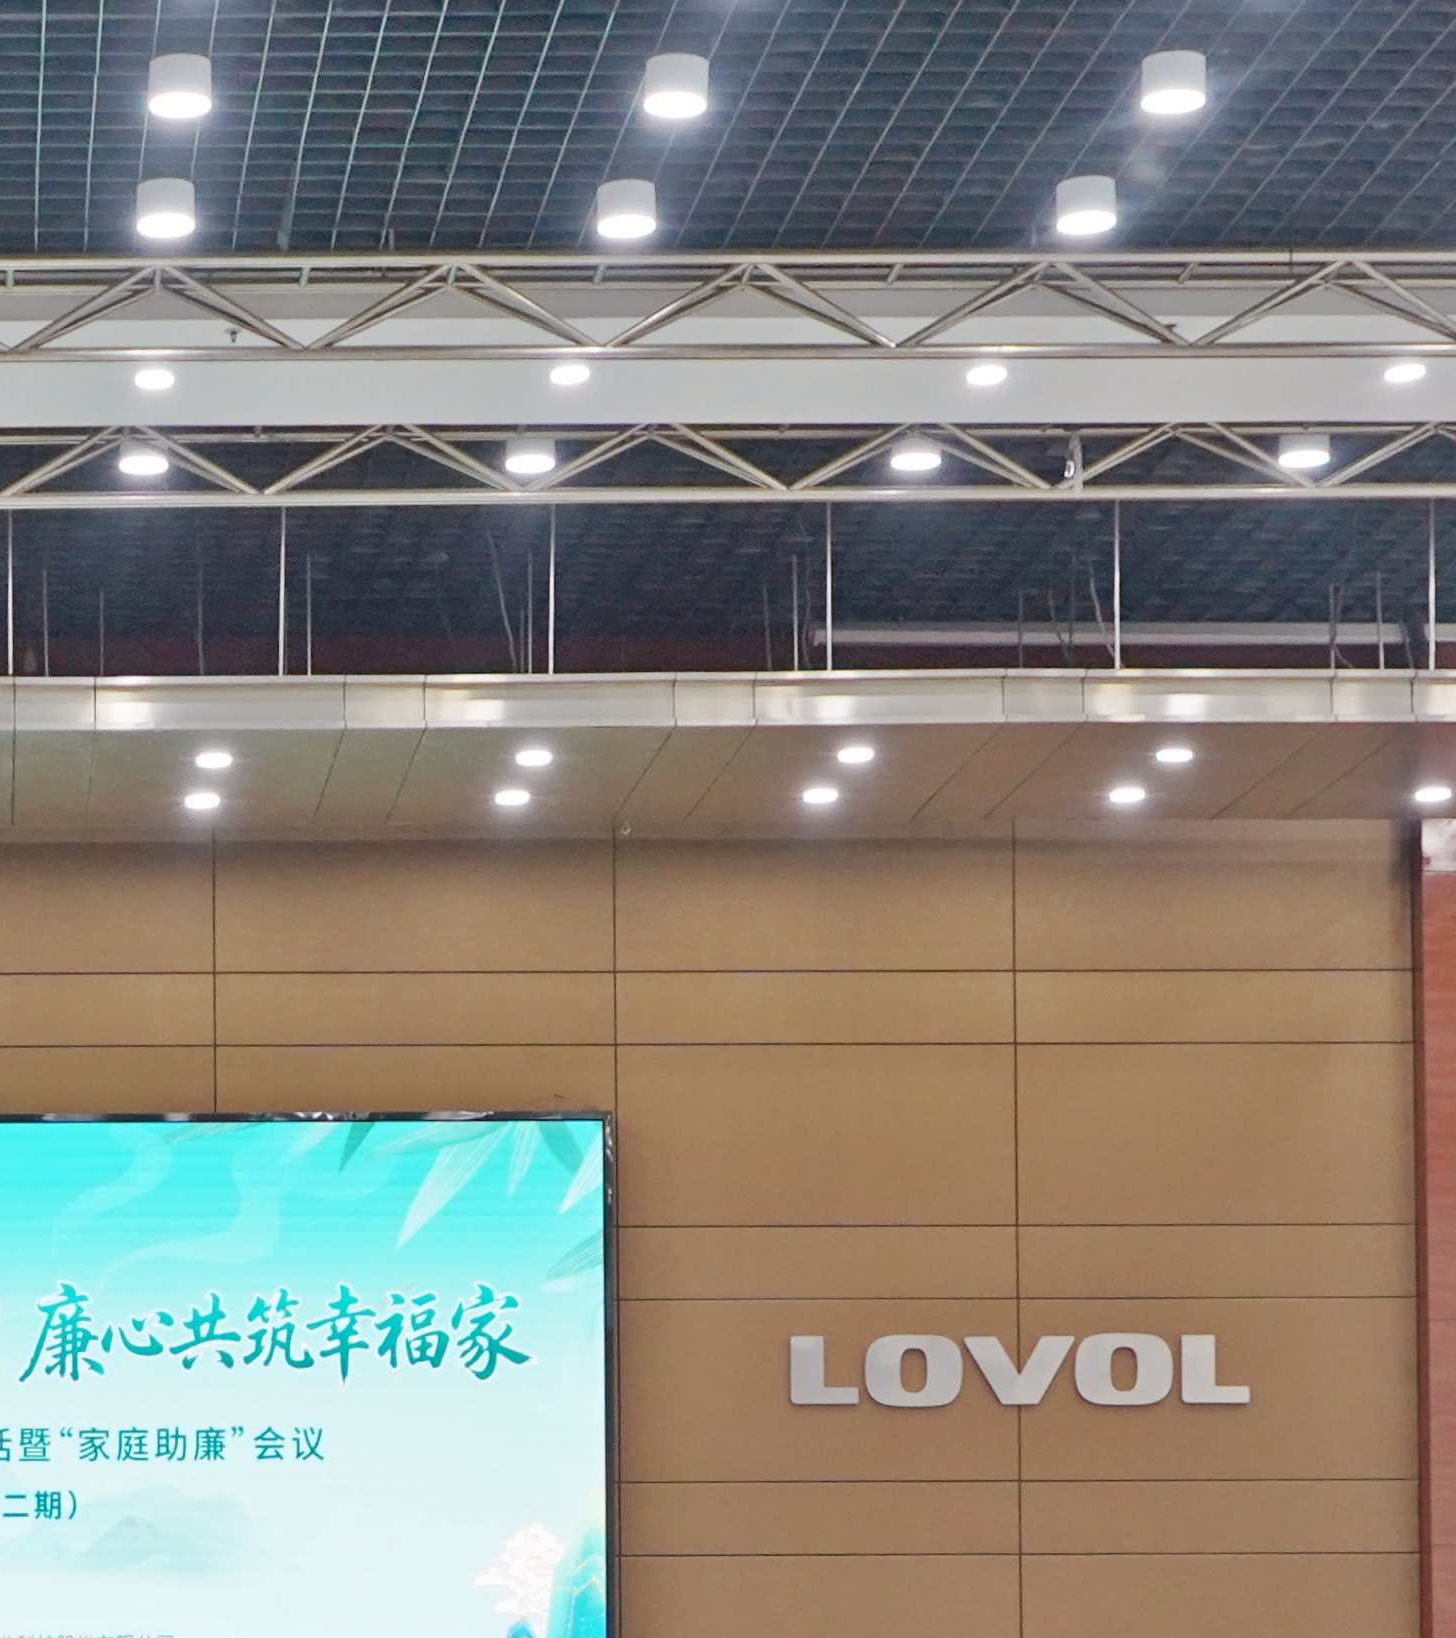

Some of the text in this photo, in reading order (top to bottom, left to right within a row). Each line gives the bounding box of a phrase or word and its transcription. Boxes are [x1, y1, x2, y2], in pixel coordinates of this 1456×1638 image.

[17, 1281, 535, 1386] 廉心共筑幸福家
[789, 1332, 1251, 1408] LOVOL
